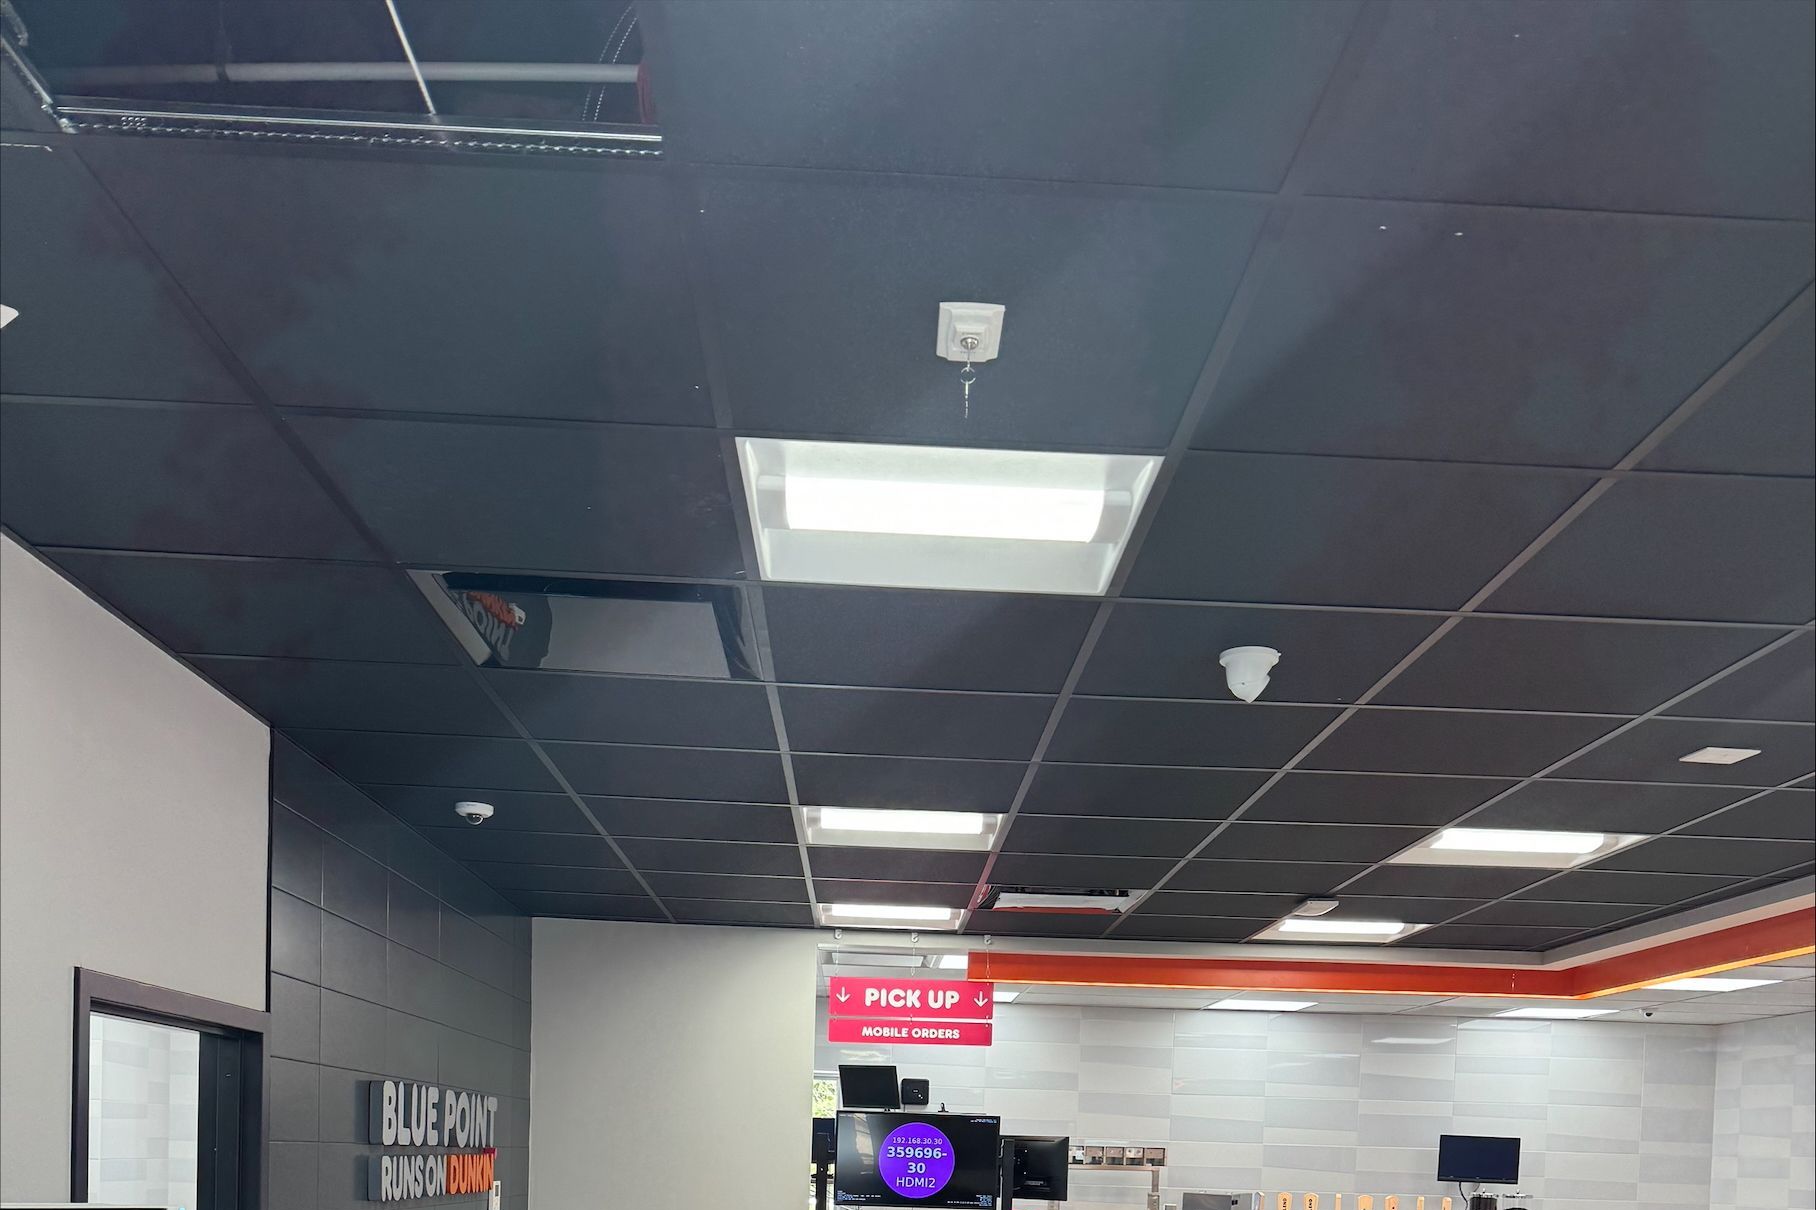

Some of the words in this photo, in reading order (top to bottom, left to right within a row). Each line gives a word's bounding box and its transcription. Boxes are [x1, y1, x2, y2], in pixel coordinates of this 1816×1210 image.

[865, 988, 921, 1009] PICK
[928, 989, 960, 1010] UP
[862, 1026, 909, 1038] MOBILE
[911, 1028, 960, 1039] ORDERS
[382, 1080, 440, 1146] BLUE
[444, 1089, 498, 1148] POINT
[892, 1136, 943, 1145] 192.168.30.30
[887, 1146, 948, 1159] 359696-
[907, 1162, 926, 1174] 30
[896, 1176, 936, 1189] HDMI2
